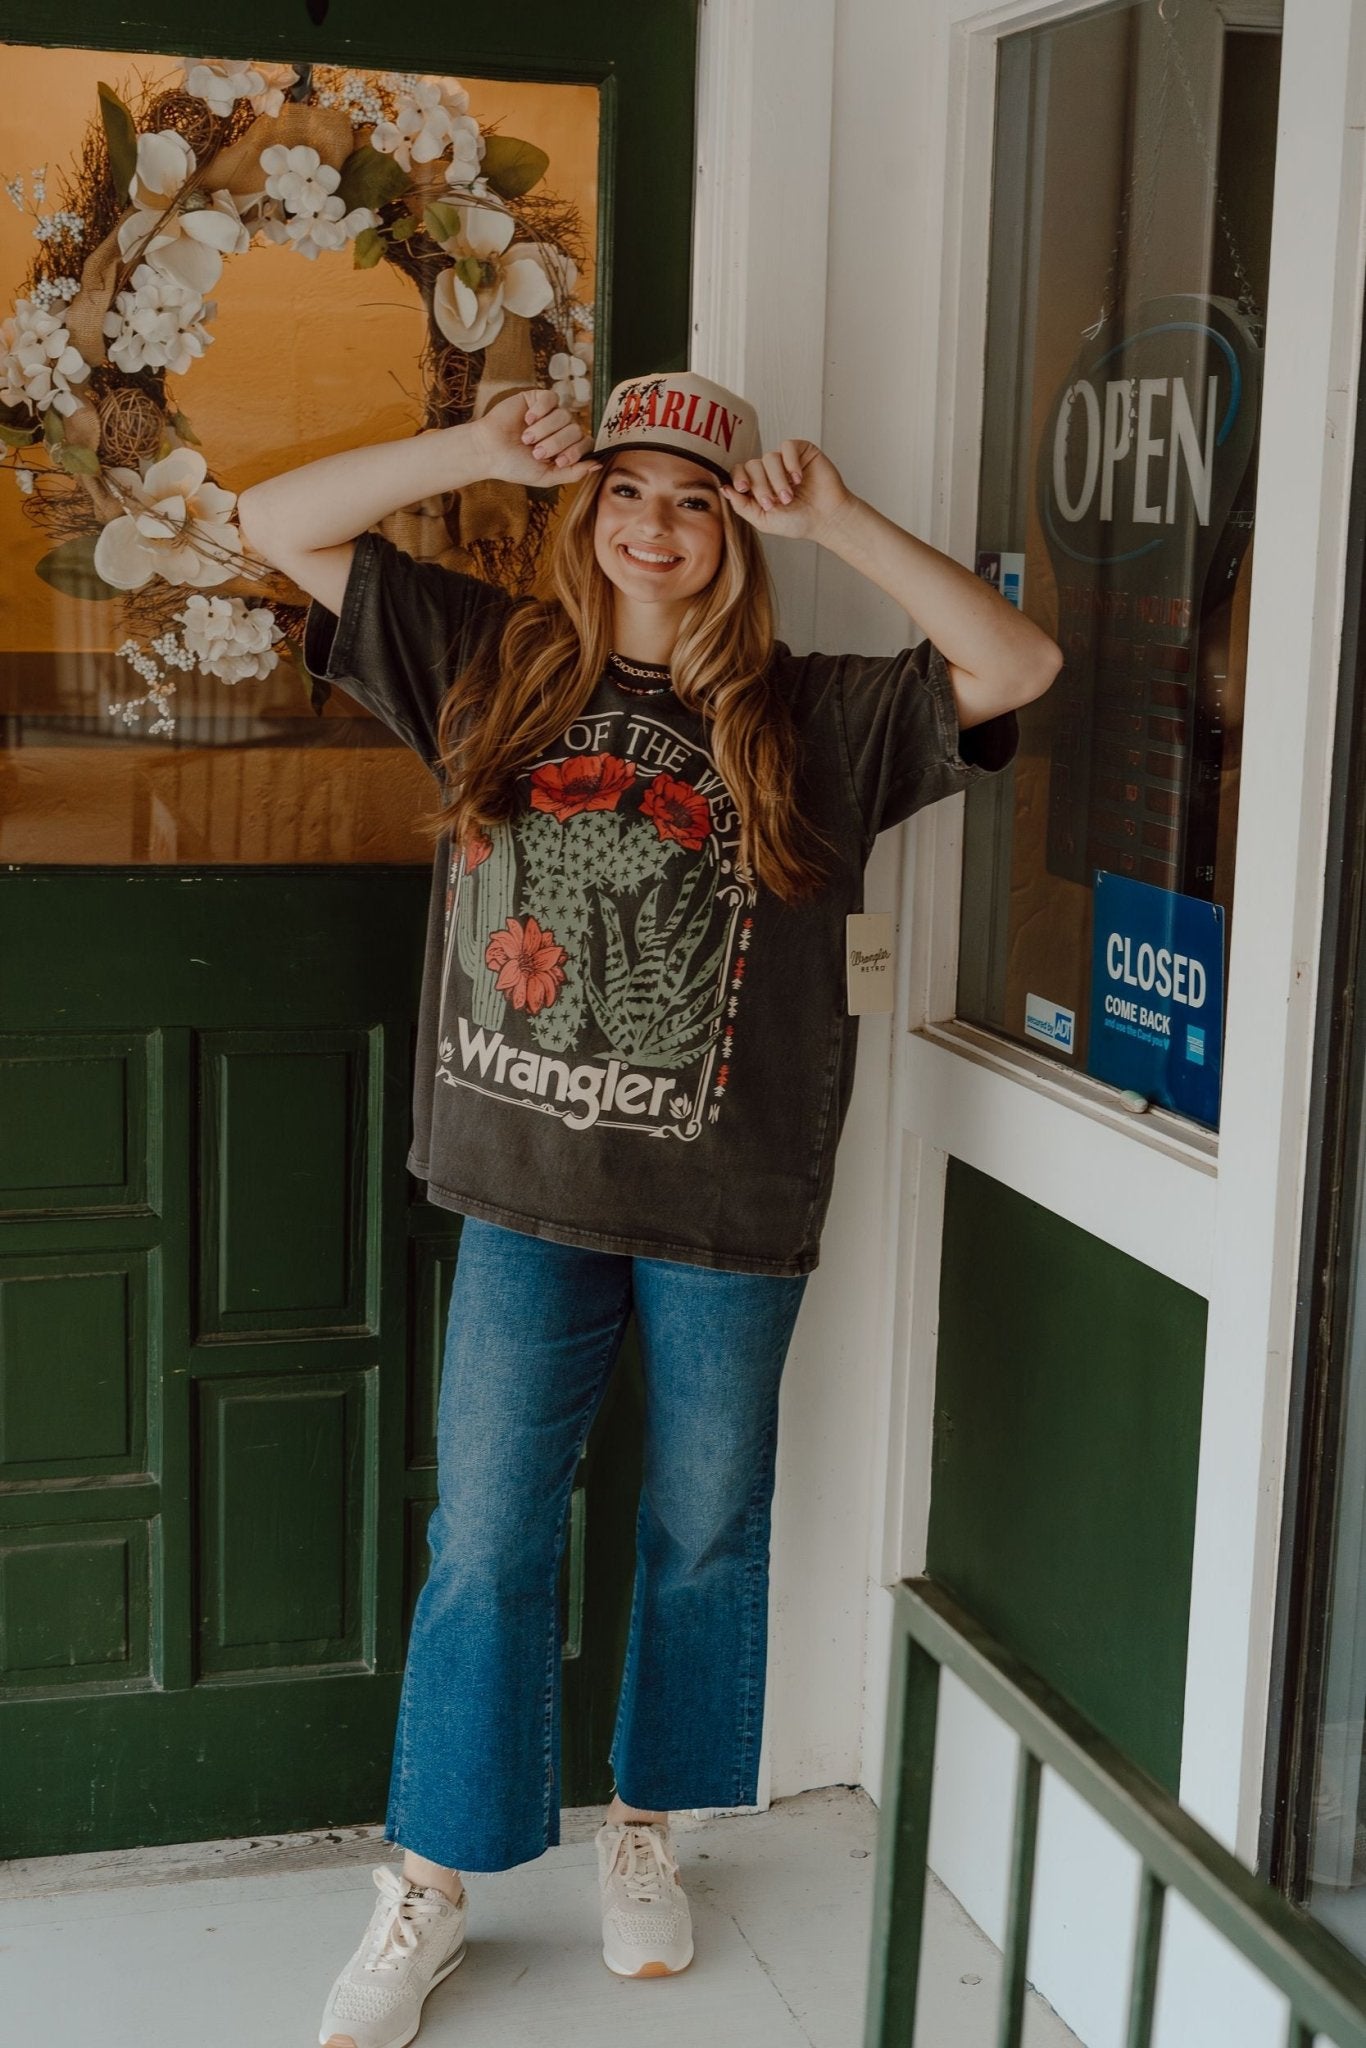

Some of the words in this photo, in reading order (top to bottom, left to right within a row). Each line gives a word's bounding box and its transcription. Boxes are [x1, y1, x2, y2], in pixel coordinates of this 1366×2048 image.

[1053, 375, 1218, 526] OPEN
[564, 720, 611, 751] OF
[626, 722, 692, 773] THE
[1106, 932, 1206, 1008] CLOSED
[1055, 1018, 1072, 1041] ADT
[1105, 994, 1138, 1023] COME
[1140, 1007, 1171, 1036] BACK
[458, 1016, 676, 1131] Wrangler
